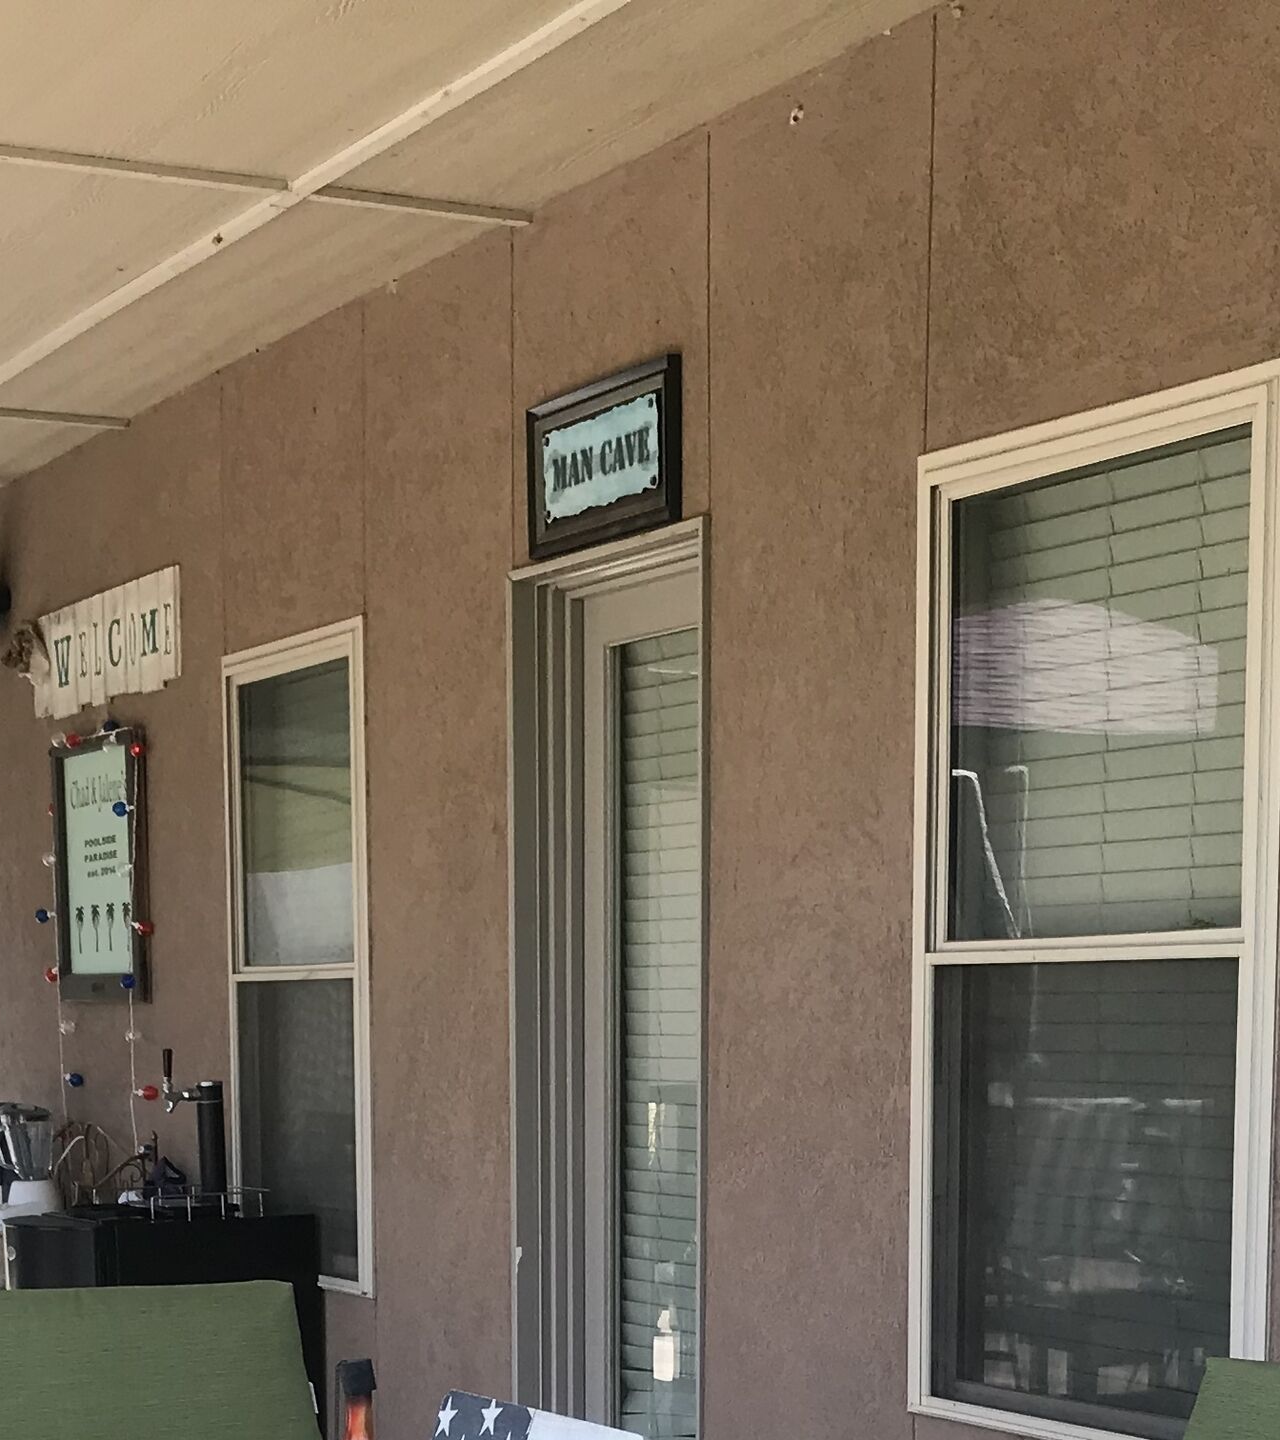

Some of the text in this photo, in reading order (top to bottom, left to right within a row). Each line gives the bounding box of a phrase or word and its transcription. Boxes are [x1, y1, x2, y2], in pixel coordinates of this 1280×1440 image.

[552, 426, 650, 492] MAN CAVE
[54, 603, 172, 688] WELCOME
[84, 834, 116, 848] POOLSIDE
[84, 849, 118, 863] PARADISE
